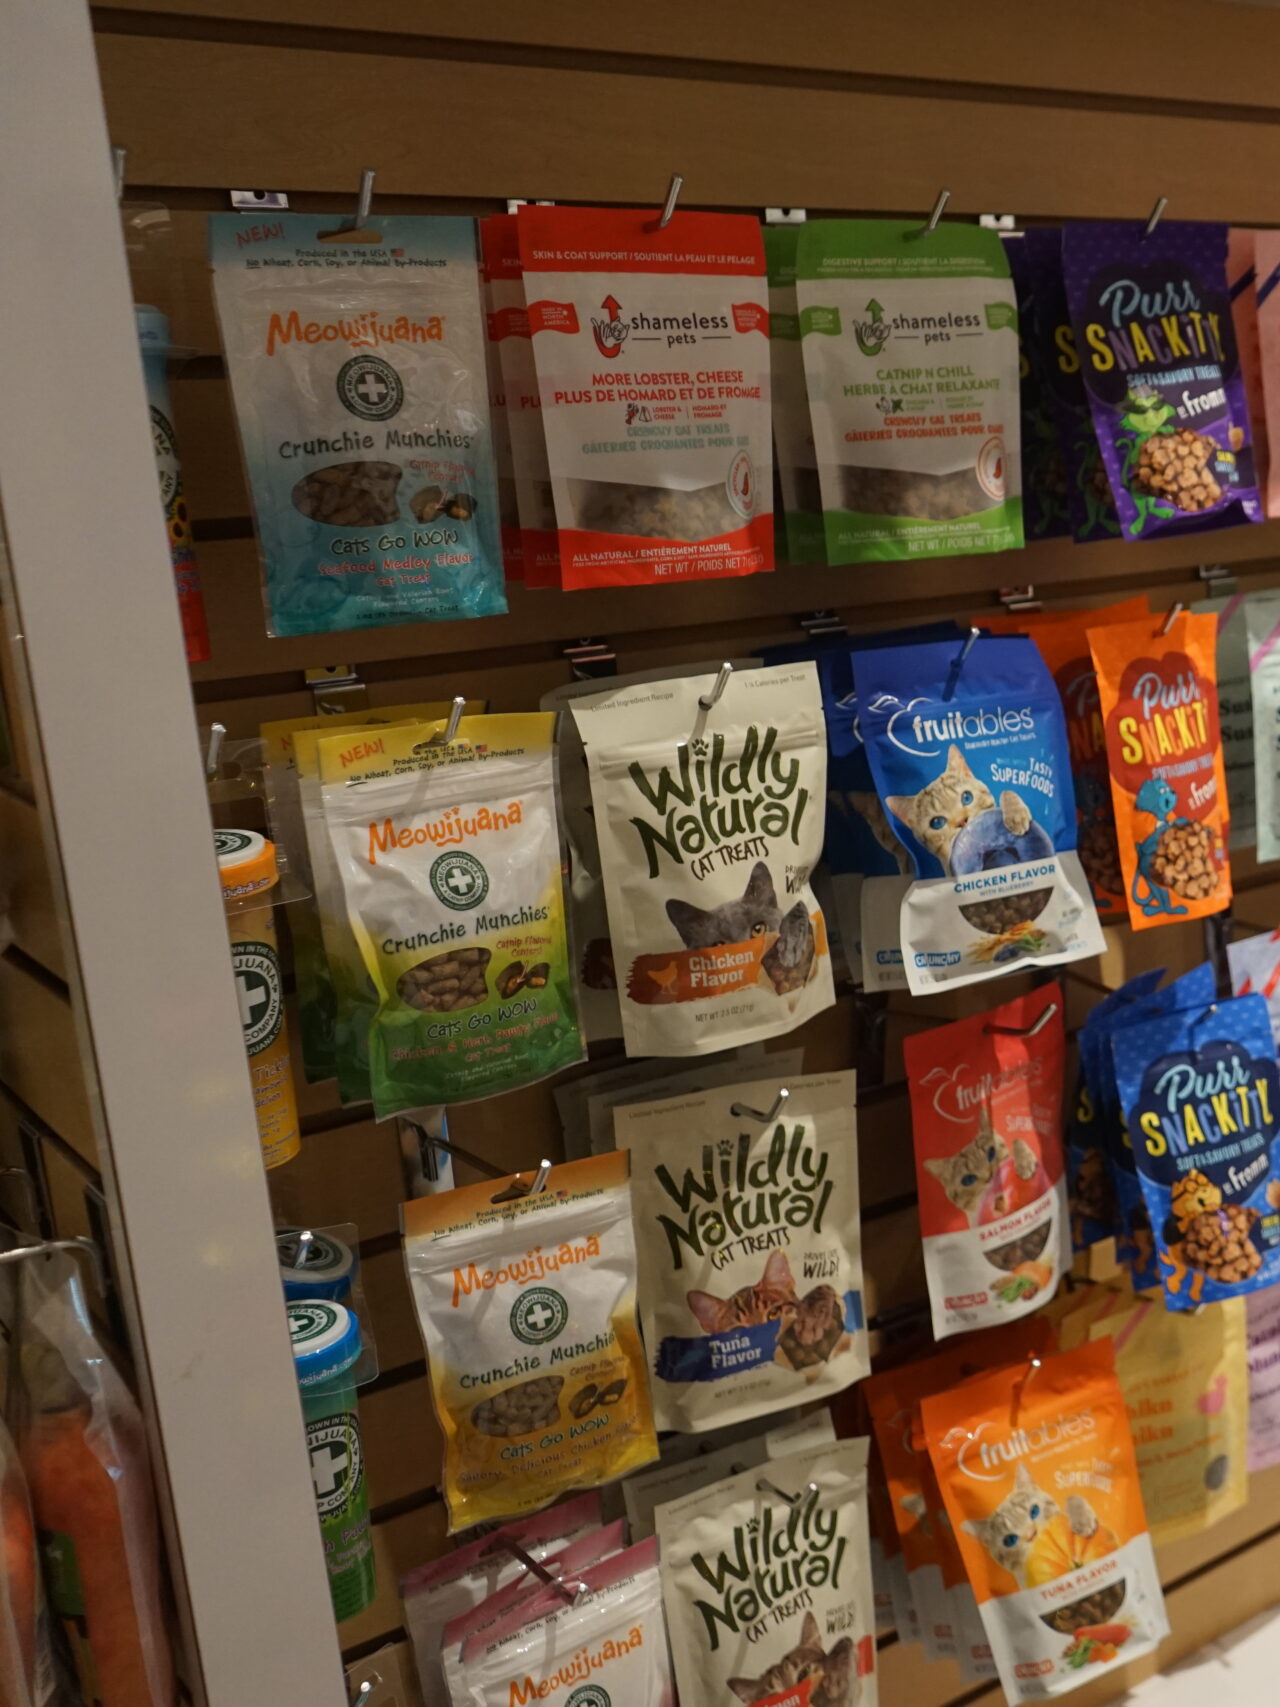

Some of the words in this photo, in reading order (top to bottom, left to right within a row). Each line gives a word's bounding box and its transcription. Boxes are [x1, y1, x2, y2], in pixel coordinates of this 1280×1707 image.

[235, 223, 285, 246] NEW!
[246, 259, 260, 268] No
[297, 258, 321, 268] Corn,
[347, 259, 356, 267] or
[295, 248, 338, 258] Produced
[352, 248, 367, 257] the
[370, 248, 387, 257] USA
[532, 251, 555, 259] SKIN
[564, 251, 588, 260] COAT
[589, 251, 628, 260] SUPPORT
[633, 252, 674, 262] SOUTIENT
[674, 254, 685, 263] LA
[685, 254, 706, 263] PEAU
[707, 255, 716, 263] ET
[717, 255, 727, 264] LE
[726, 256, 756, 265] PELAGE
[822, 257, 863, 266] DIGESTIVE
[1099, 279, 1200, 327] Purr
[265, 310, 444, 356] Meowijuana
[631, 312, 729, 330] shameless
[891, 312, 981, 329] shameless
[666, 333, 697, 348] pets
[924, 332, 952, 346] pets
[592, 373, 631, 387] MORE
[634, 371, 695, 389] LOBSTER,
[697, 370, 744, 384] CHEESE
[876, 368, 923, 381] CATNIP
[924, 368, 935, 379] N
[936, 365, 975, 378] CHILL
[554, 390, 593, 405] PLUS
[596, 389, 616, 402] DE
[617, 388, 677, 401] HOMARD
[679, 387, 694, 399] ET
[697, 386, 716, 399] DE
[717, 385, 762, 399] FROMAGE
[843, 384, 887, 398] HERBE
[900, 382, 934, 395] CHAT
[279, 431, 374, 459] Crunchie
[386, 428, 472, 450] Munchies
[331, 537, 371, 557] Cats
[377, 535, 406, 552] Go
[414, 529, 460, 548] WOW
[590, 550, 634, 560] NATURAL
[699, 543, 732, 553] NATUREL
[317, 560, 376, 577] Seafood
[382, 556, 430, 573] Medley
[435, 552, 474, 567] Flavor
[654, 564, 672, 575] NET
[675, 563, 689, 574] WT
[697, 560, 724, 572] POIDS
[724, 558, 741, 570] NET
[616, 694, 650, 708] Ingredient
[650, 692, 675, 702] Recipe
[1133, 671, 1200, 719] Purr
[912, 706, 1035, 744] fruitables
[338, 738, 385, 768] NEW!
[392, 753, 429, 766] Produced
[430, 752, 440, 761] in
[443, 750, 457, 759] the
[457, 746, 473, 757] USA
[394, 764, 415, 776] Corn,
[418, 762, 435, 774] Soy,
[437, 759, 446, 767] or
[449, 755, 476, 766] Animal
[477, 747, 525, 762] By-Products
[629, 724, 800, 815] Wildly
[990, 763, 1055, 798] SUPERFOODS
[1029, 758, 1054, 778] TASTY
[368, 800, 524, 864] Meowijuana
[629, 787, 809, 879] Natural
[690, 854, 716, 881] CAT
[716, 836, 770, 868] TREATS
[954, 874, 1008, 893] CHICKEN
[1010, 864, 1057, 881] FLAVOR
[979, 889, 997, 897] WITH
[997, 881, 1035, 895] BLUEBERRY
[382, 922, 466, 955] Crunchie
[475, 905, 548, 936] Munchies
[496, 936, 524, 949] Catnip
[688, 950, 755, 972] Chicken
[915, 952, 961, 967] CRUNCHY
[690, 969, 745, 988] Flavor
[427, 1020, 461, 1040] Cats
[467, 1012, 491, 1031] Go
[498, 998, 537, 1022] WOW
[695, 1013, 709, 1023] NET
[709, 1012, 720, 1021] WT
[1153, 1055, 1252, 1113] Purr
[654, 1123, 829, 1213] Wildly
[433, 1229, 446, 1238] No
[477, 1216, 500, 1227] Corn,
[519, 1208, 530, 1216] or
[531, 1200, 558, 1213] Animal
[559, 1188, 604, 1206] By-Products
[476, 1205, 512, 1219] Produced
[514, 1202, 524, 1210] in
[524, 1198, 538, 1208] the
[538, 1193, 555, 1203] USA
[655, 1179, 834, 1270] Natural
[979, 1217, 1023, 1241] SALMON
[710, 1243, 734, 1271] CAT
[736, 1227, 791, 1256] TREATS
[451, 1234, 600, 1309] Meowijuana
[709, 1335, 751, 1355] Tuna
[711, 1347, 762, 1369] Flavor
[459, 1355, 541, 1389] Crunchie
[500, 1440, 534, 1461] Cats
[539, 1432, 564, 1450] Go
[569, 1414, 610, 1439] WOW
[979, 1411, 1096, 1470] fruitables
[511, 1452, 566, 1475] Delicious
[569, 1431, 612, 1455] Chicken
[690, 1492, 838, 1594] Wildly
[1040, 1581, 1073, 1600] TUNA
[1076, 1559, 1118, 1585] FLAVOR
[693, 1536, 846, 1652] Natural
[745, 1619, 770, 1643] CAT
[770, 1588, 814, 1625] TREATS
[508, 1625, 643, 1707] Meowijuana
